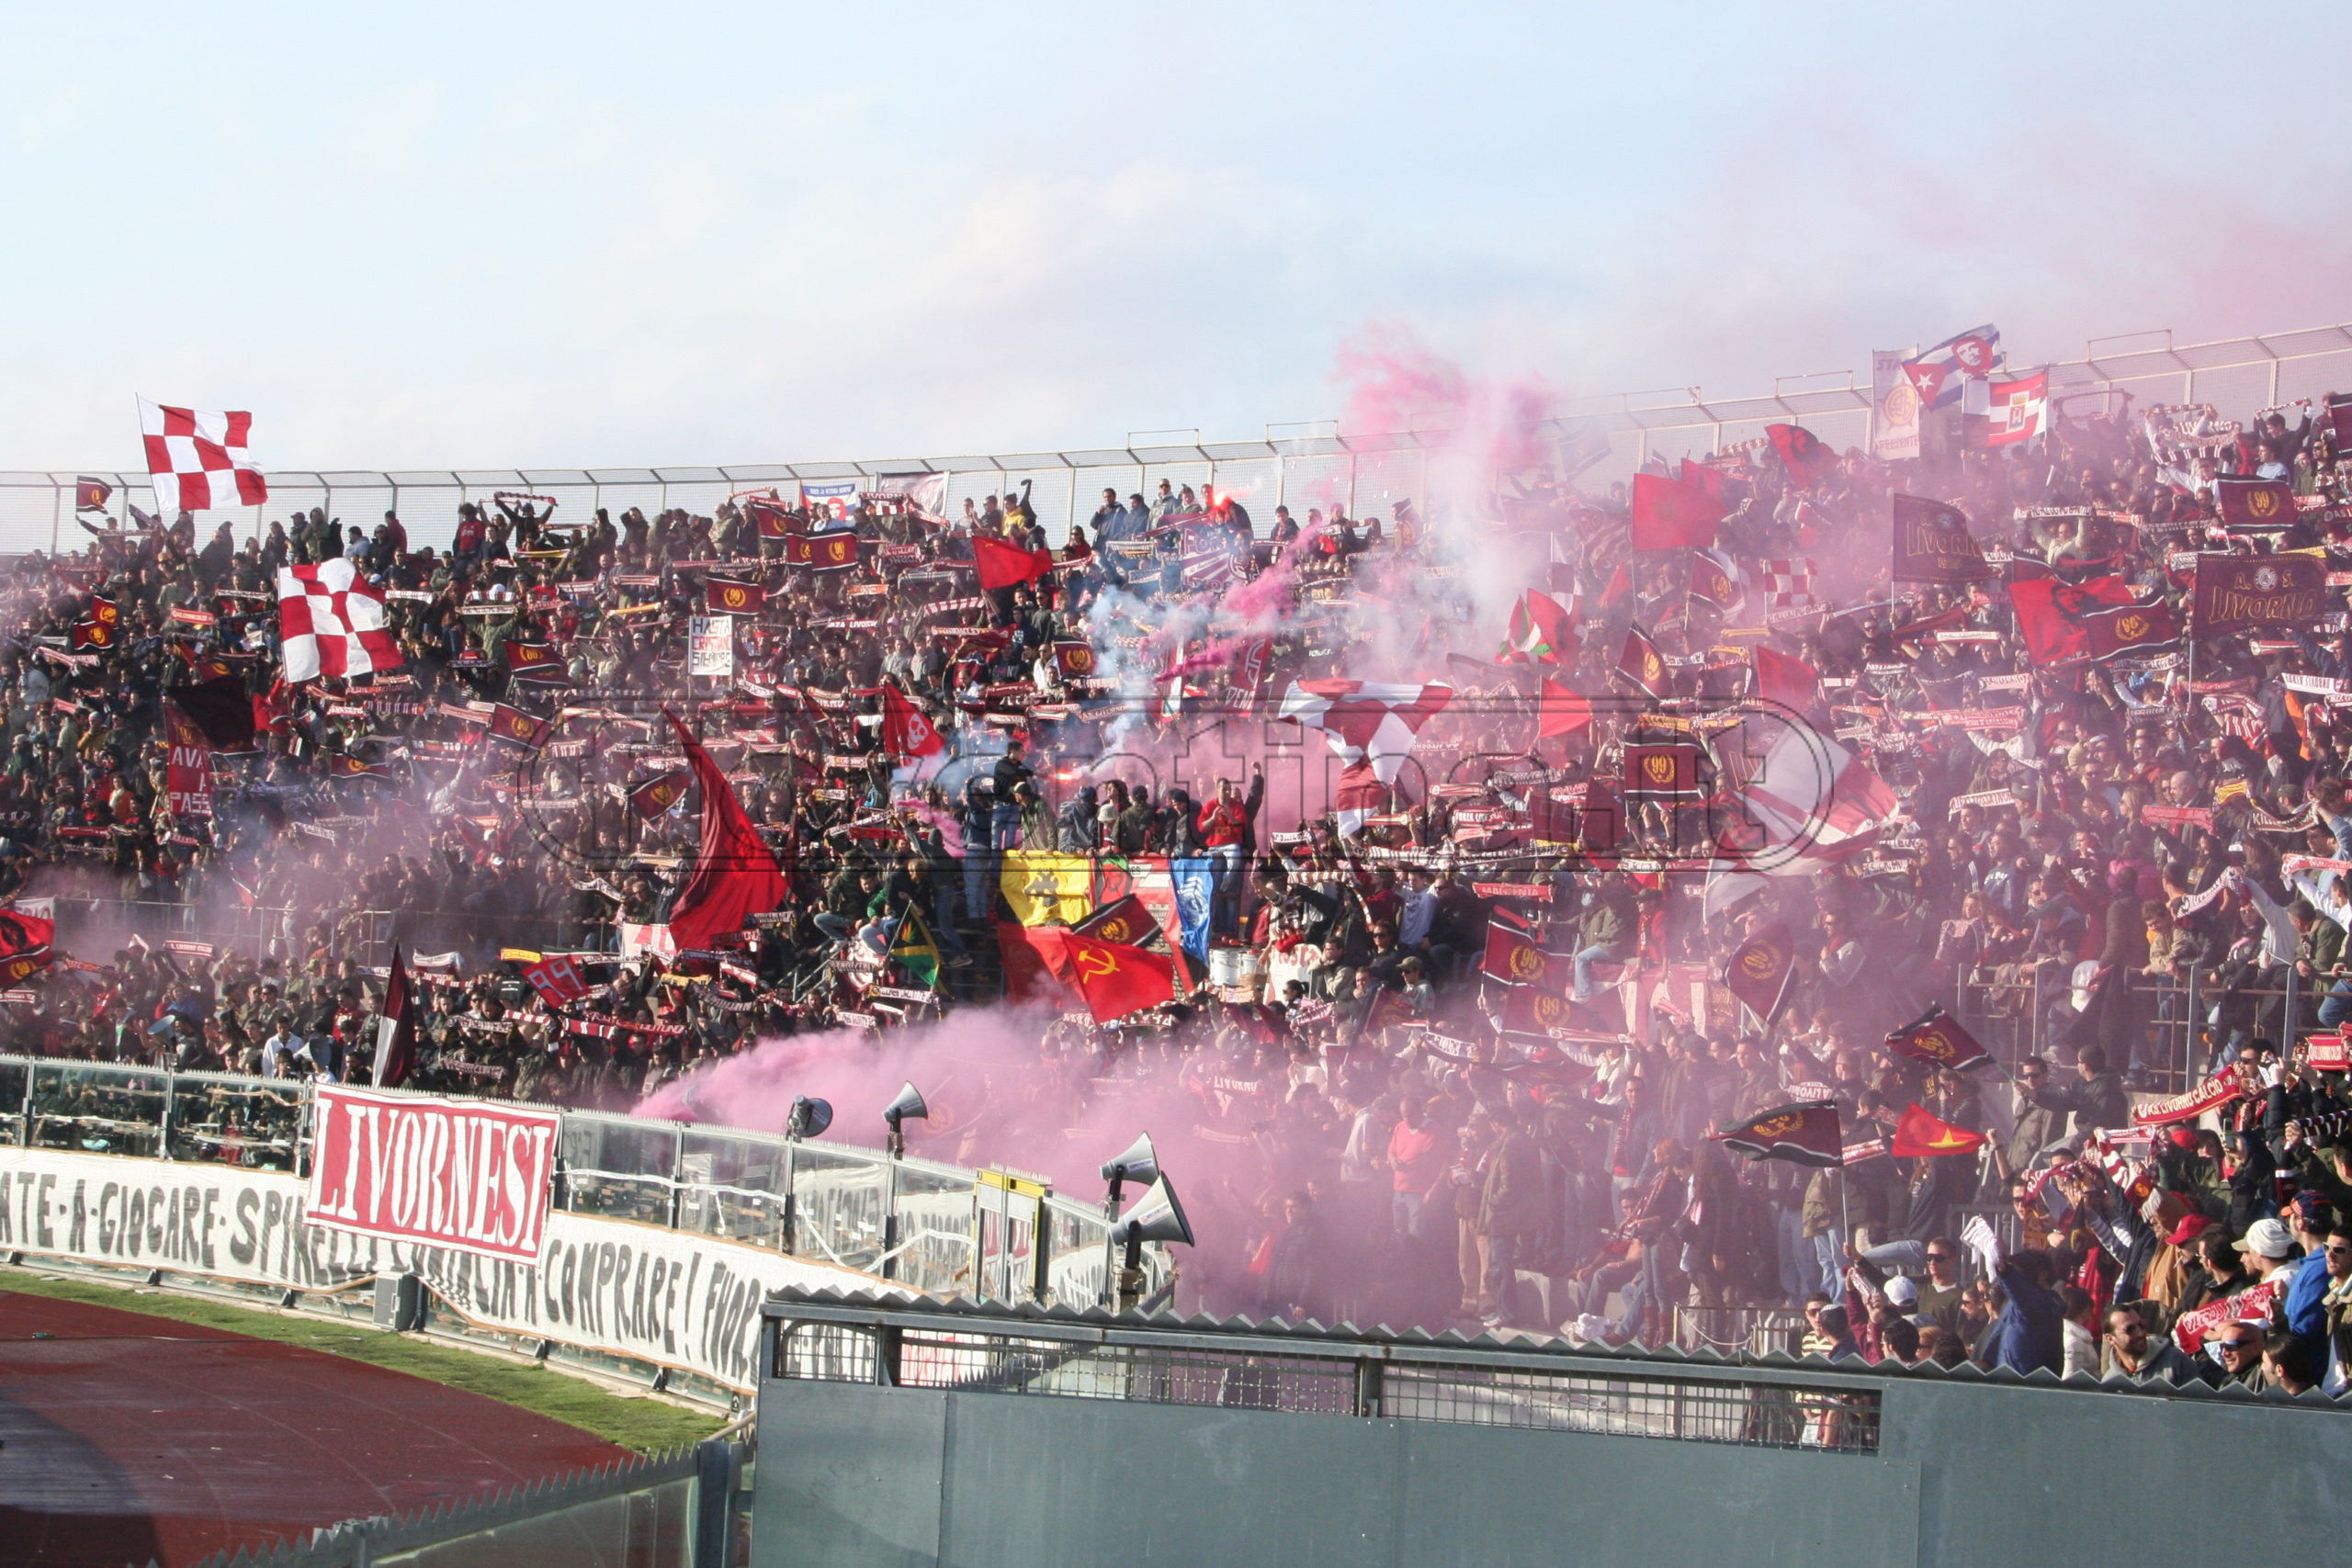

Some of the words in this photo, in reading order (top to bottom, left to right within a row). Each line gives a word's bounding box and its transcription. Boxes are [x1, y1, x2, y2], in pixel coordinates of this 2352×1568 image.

[2209, 585, 2319, 625] LIVORNO
[2193, 1078, 2224, 1104] CALCIO
[309, 1098, 551, 1252] LIVORNESI
[97, 1180, 220, 1270] GIOCARE
